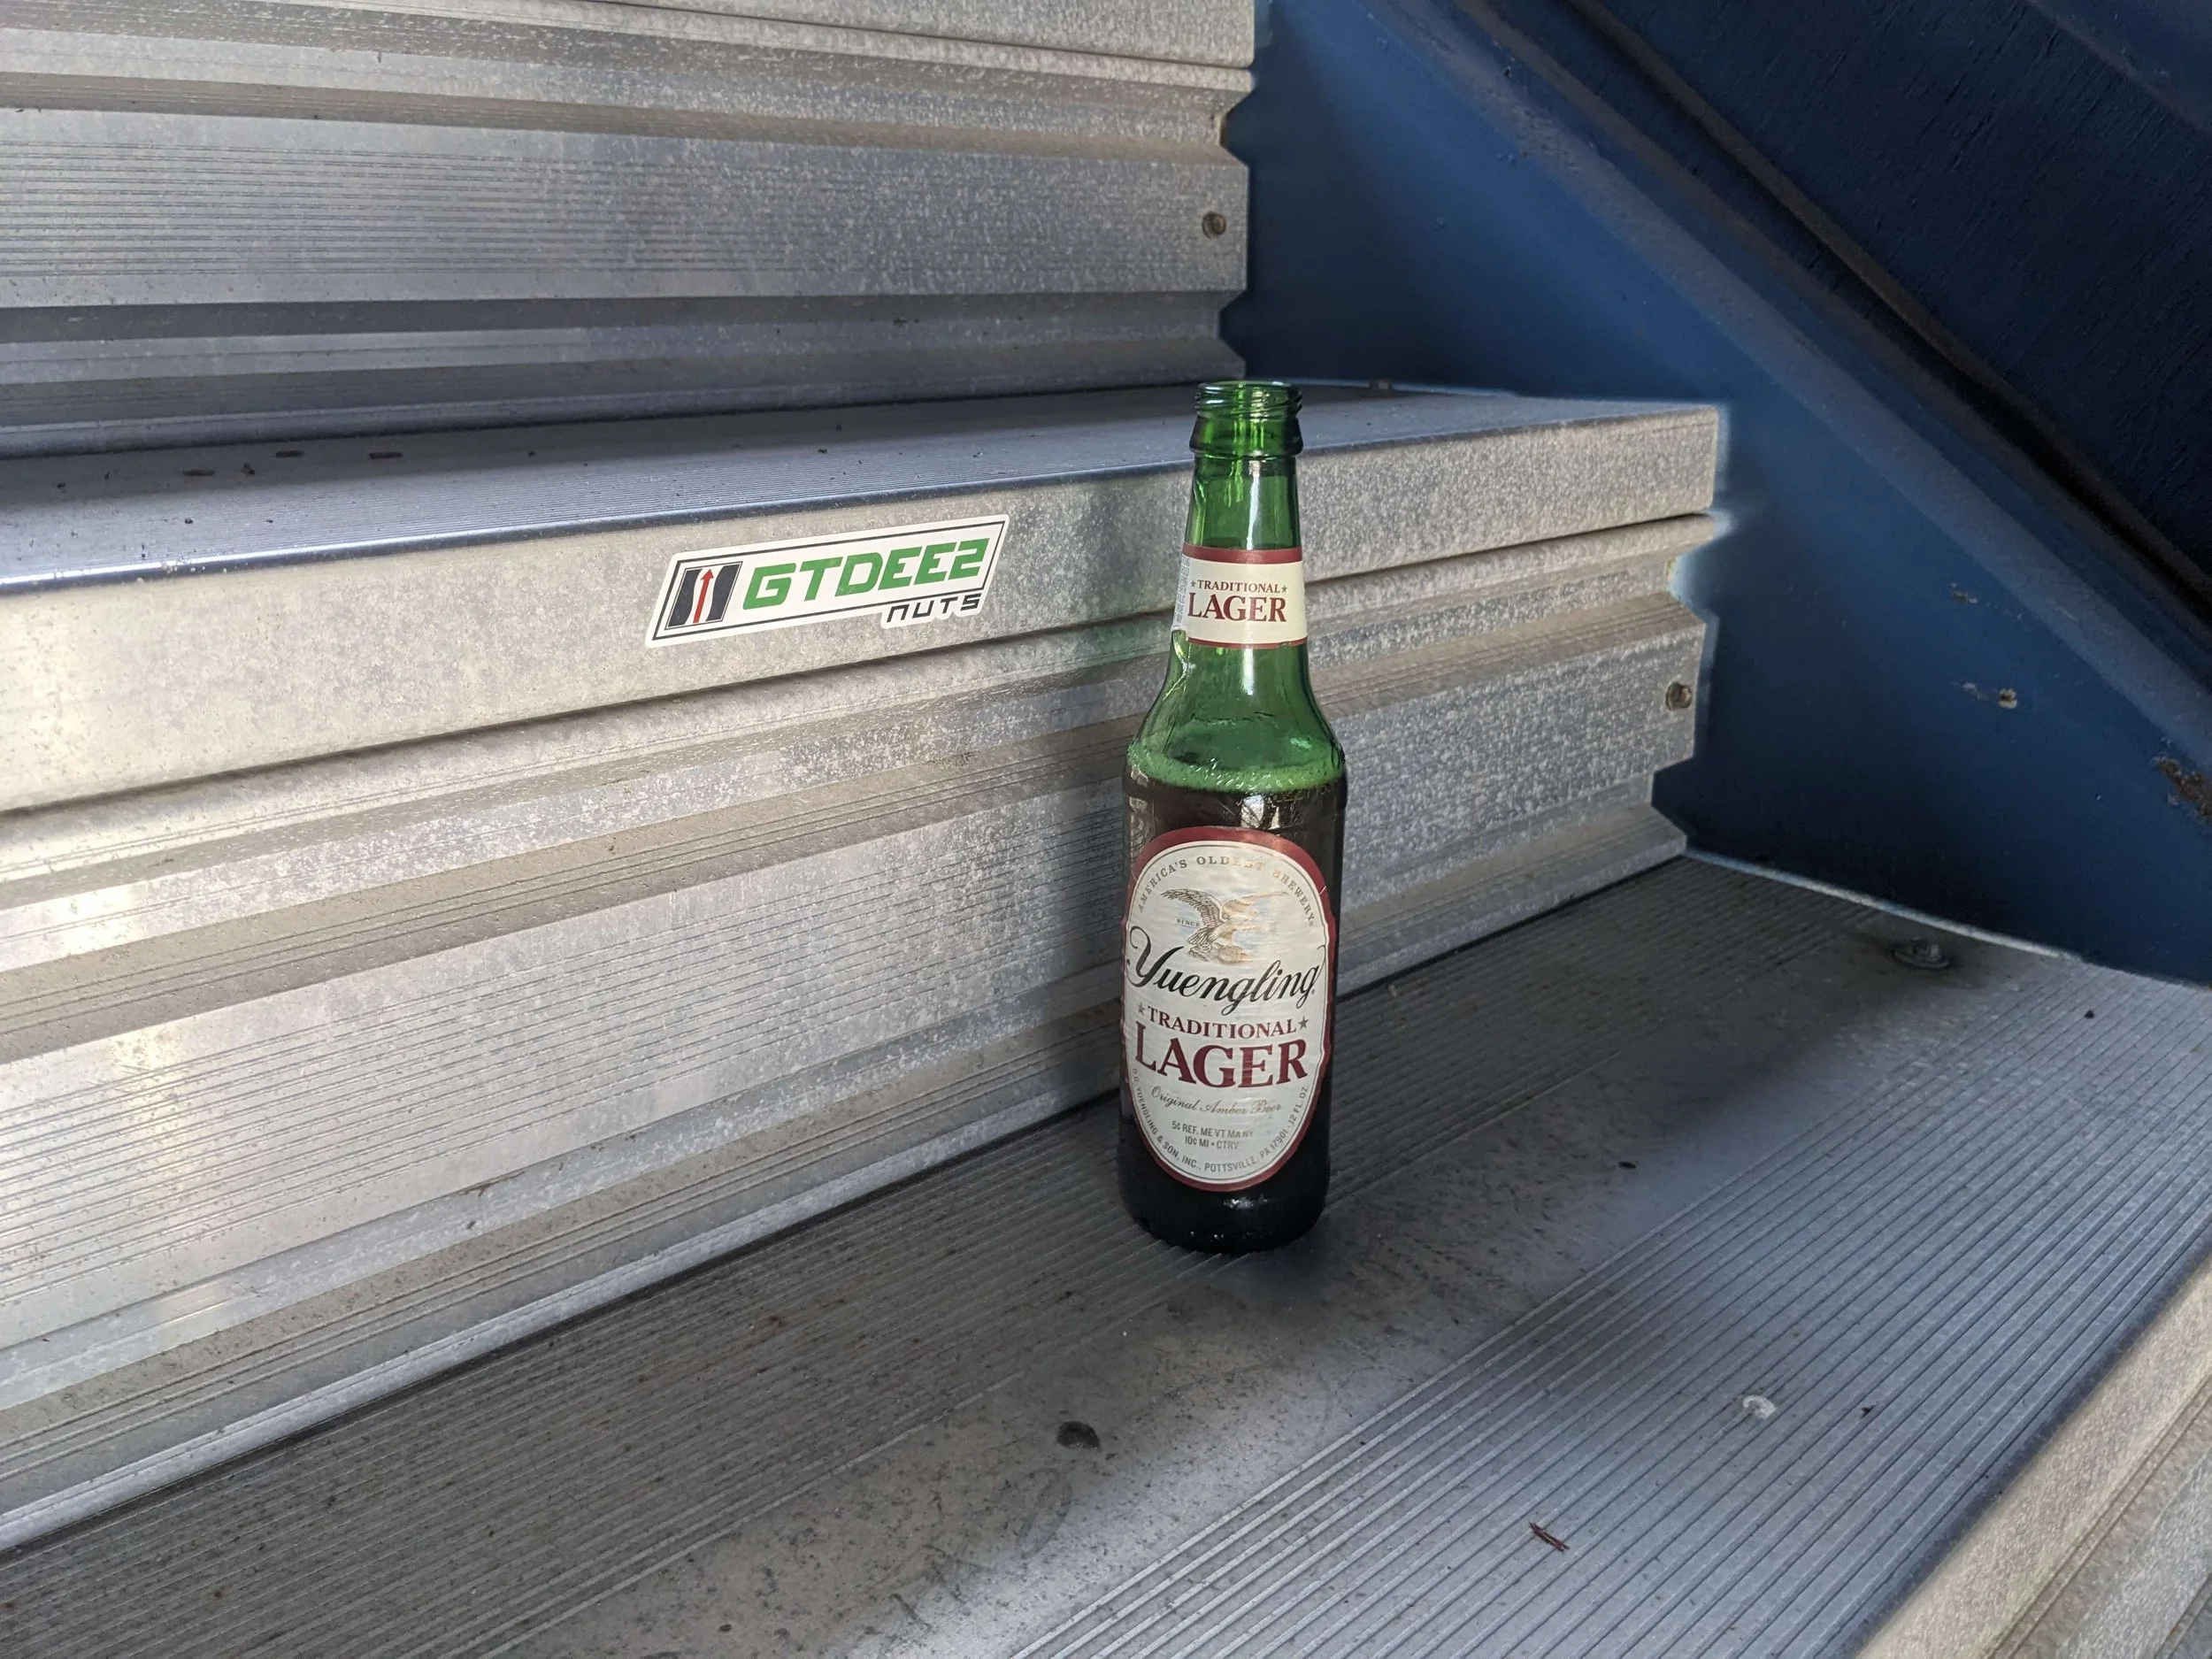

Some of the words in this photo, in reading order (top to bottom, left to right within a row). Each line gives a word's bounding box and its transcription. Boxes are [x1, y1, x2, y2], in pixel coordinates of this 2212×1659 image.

[1197, 580, 1280, 594] TRADITIONAL
[1187, 592, 1287, 623] LAGER
[1138, 859, 1187, 913] AMERICA'S
[1273, 870, 1315, 922] BREWERY
[1127, 926, 1326, 1016] Yuengling
[1148, 1005, 1297, 1039] TRADITIONAL
[1135, 1020, 1308, 1088] LAGER
[1151, 1085, 1201, 1110] Original
[1200, 1098, 1247, 1115] Amber
